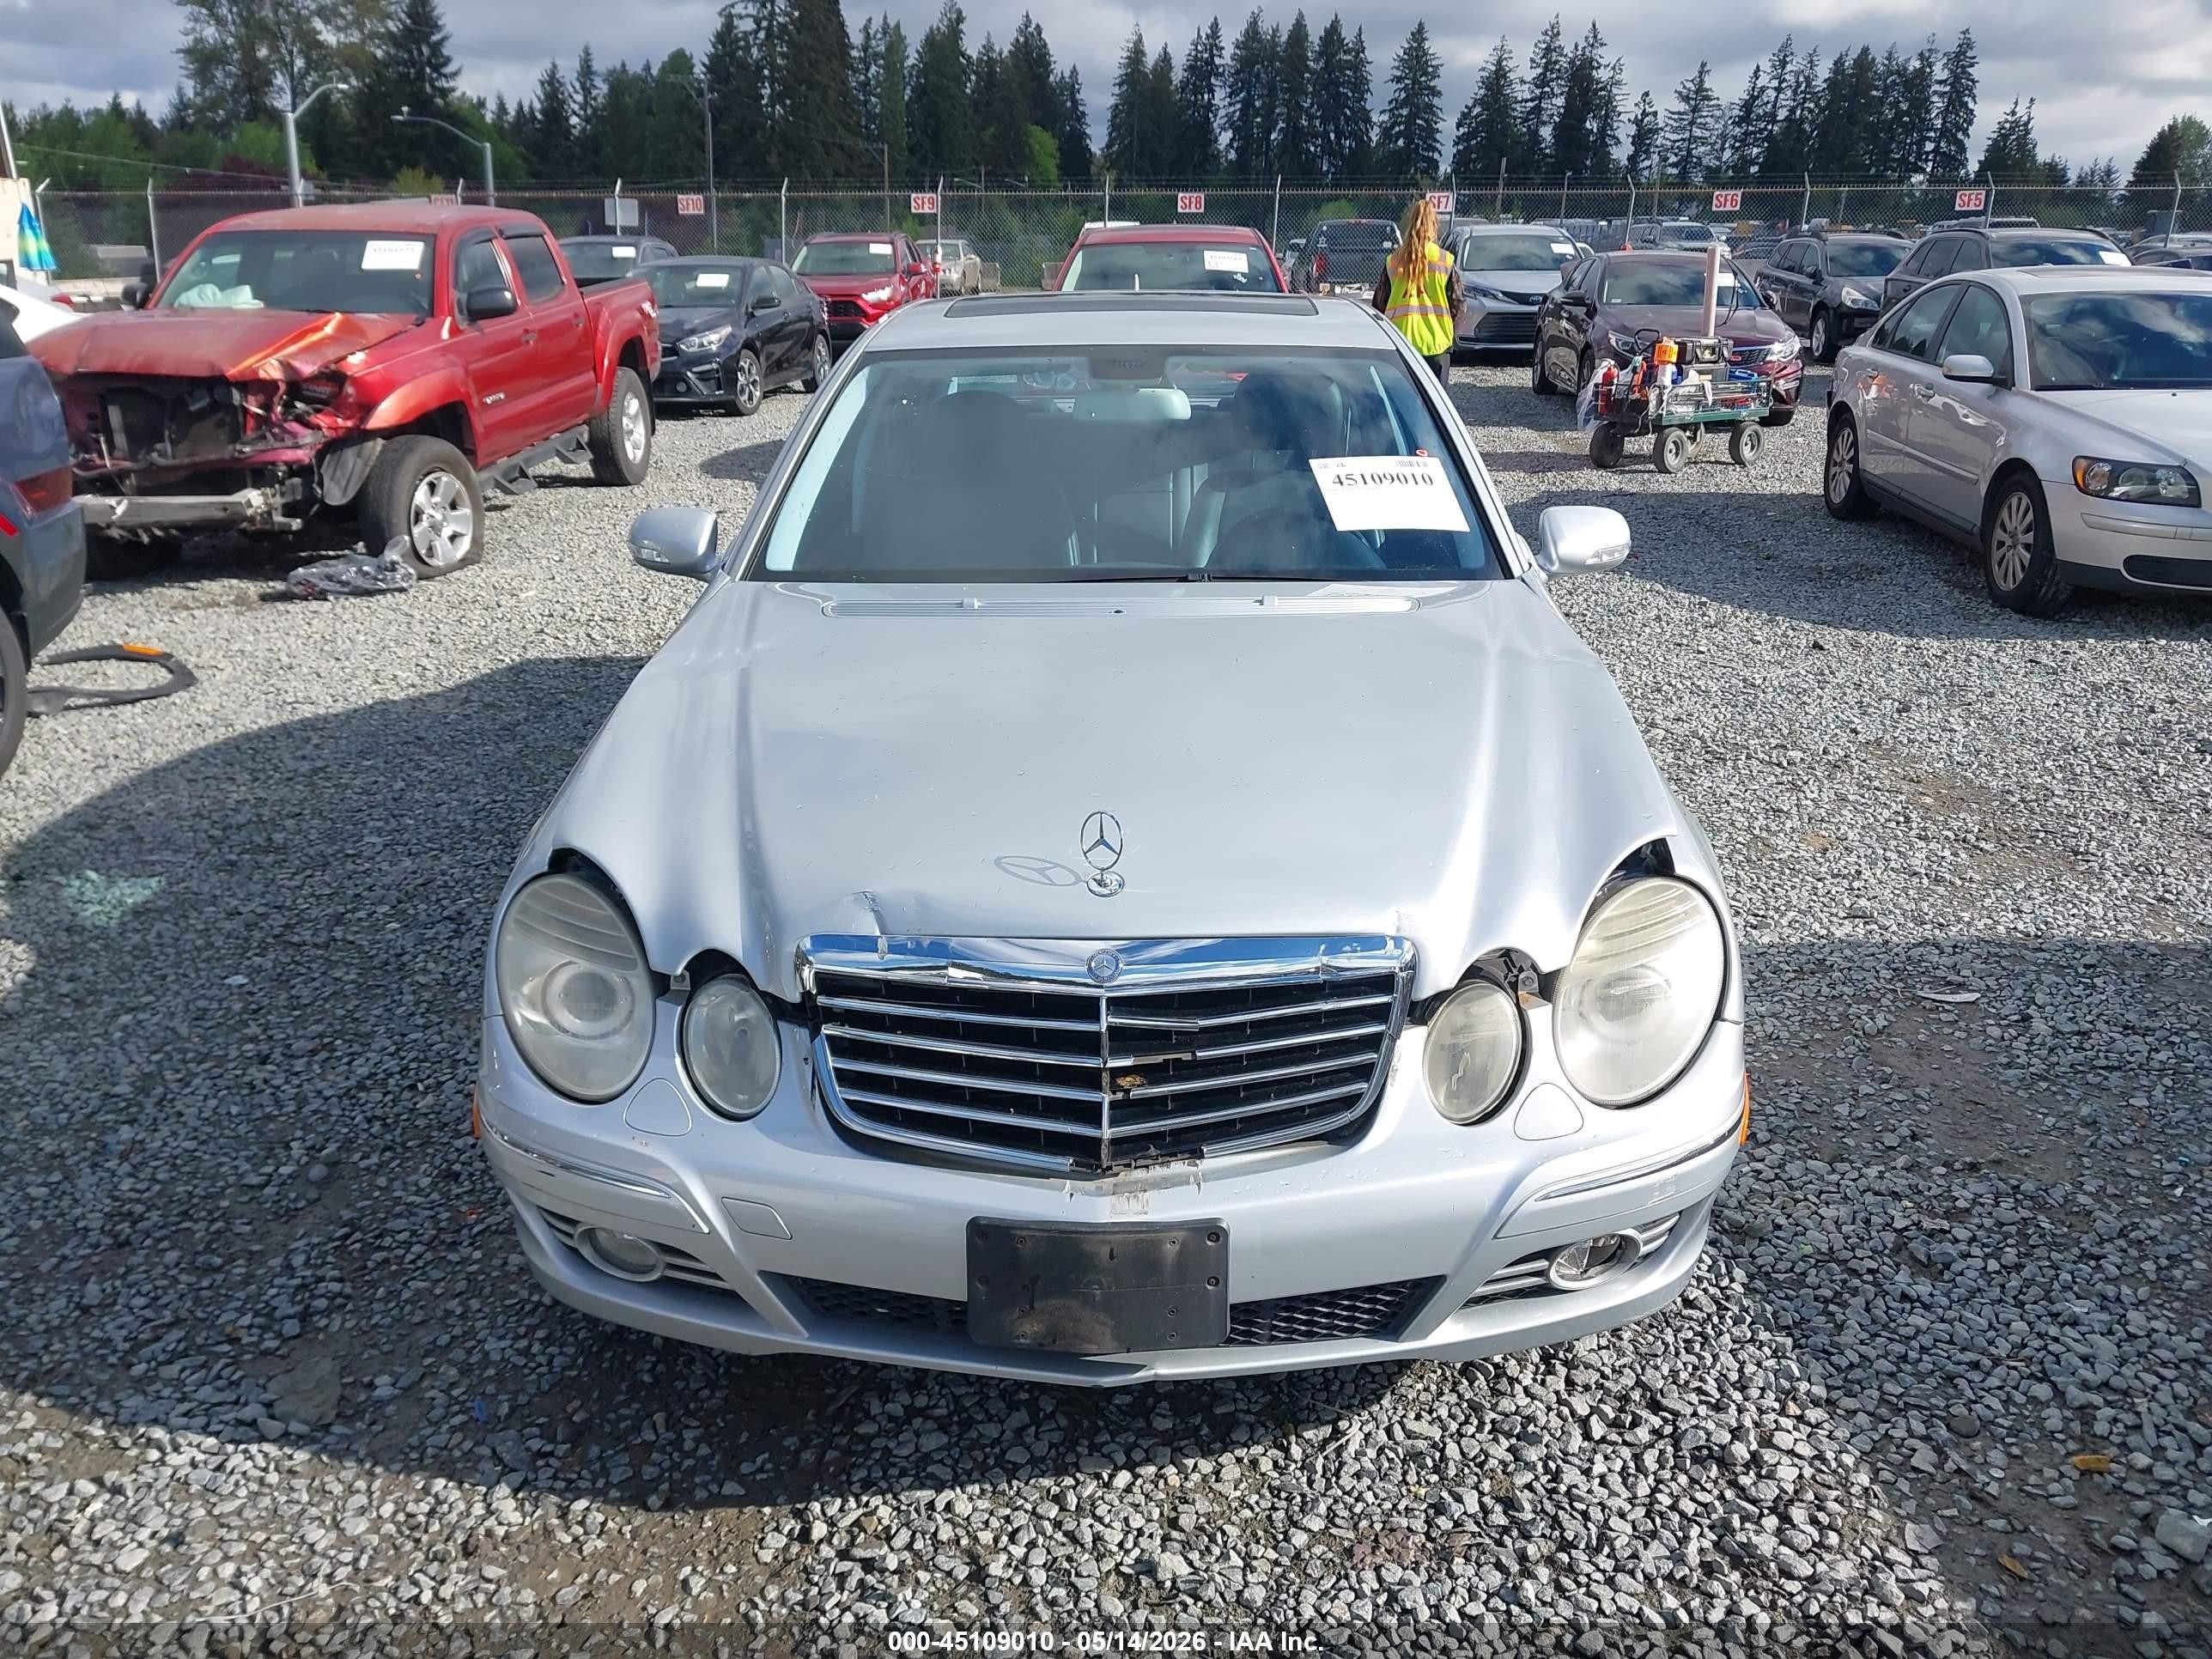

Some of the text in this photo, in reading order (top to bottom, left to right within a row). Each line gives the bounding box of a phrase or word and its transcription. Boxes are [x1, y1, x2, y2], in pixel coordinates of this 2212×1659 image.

[678, 197, 702, 212] SF10
[913, 196, 935, 211] SF9
[1180, 195, 1202, 210] SF8
[1429, 194, 1450, 210] SF7
[1714, 192, 1739, 209] SF6
[1958, 191, 1983, 208] SF5
[1332, 471, 1434, 487] 45109010
